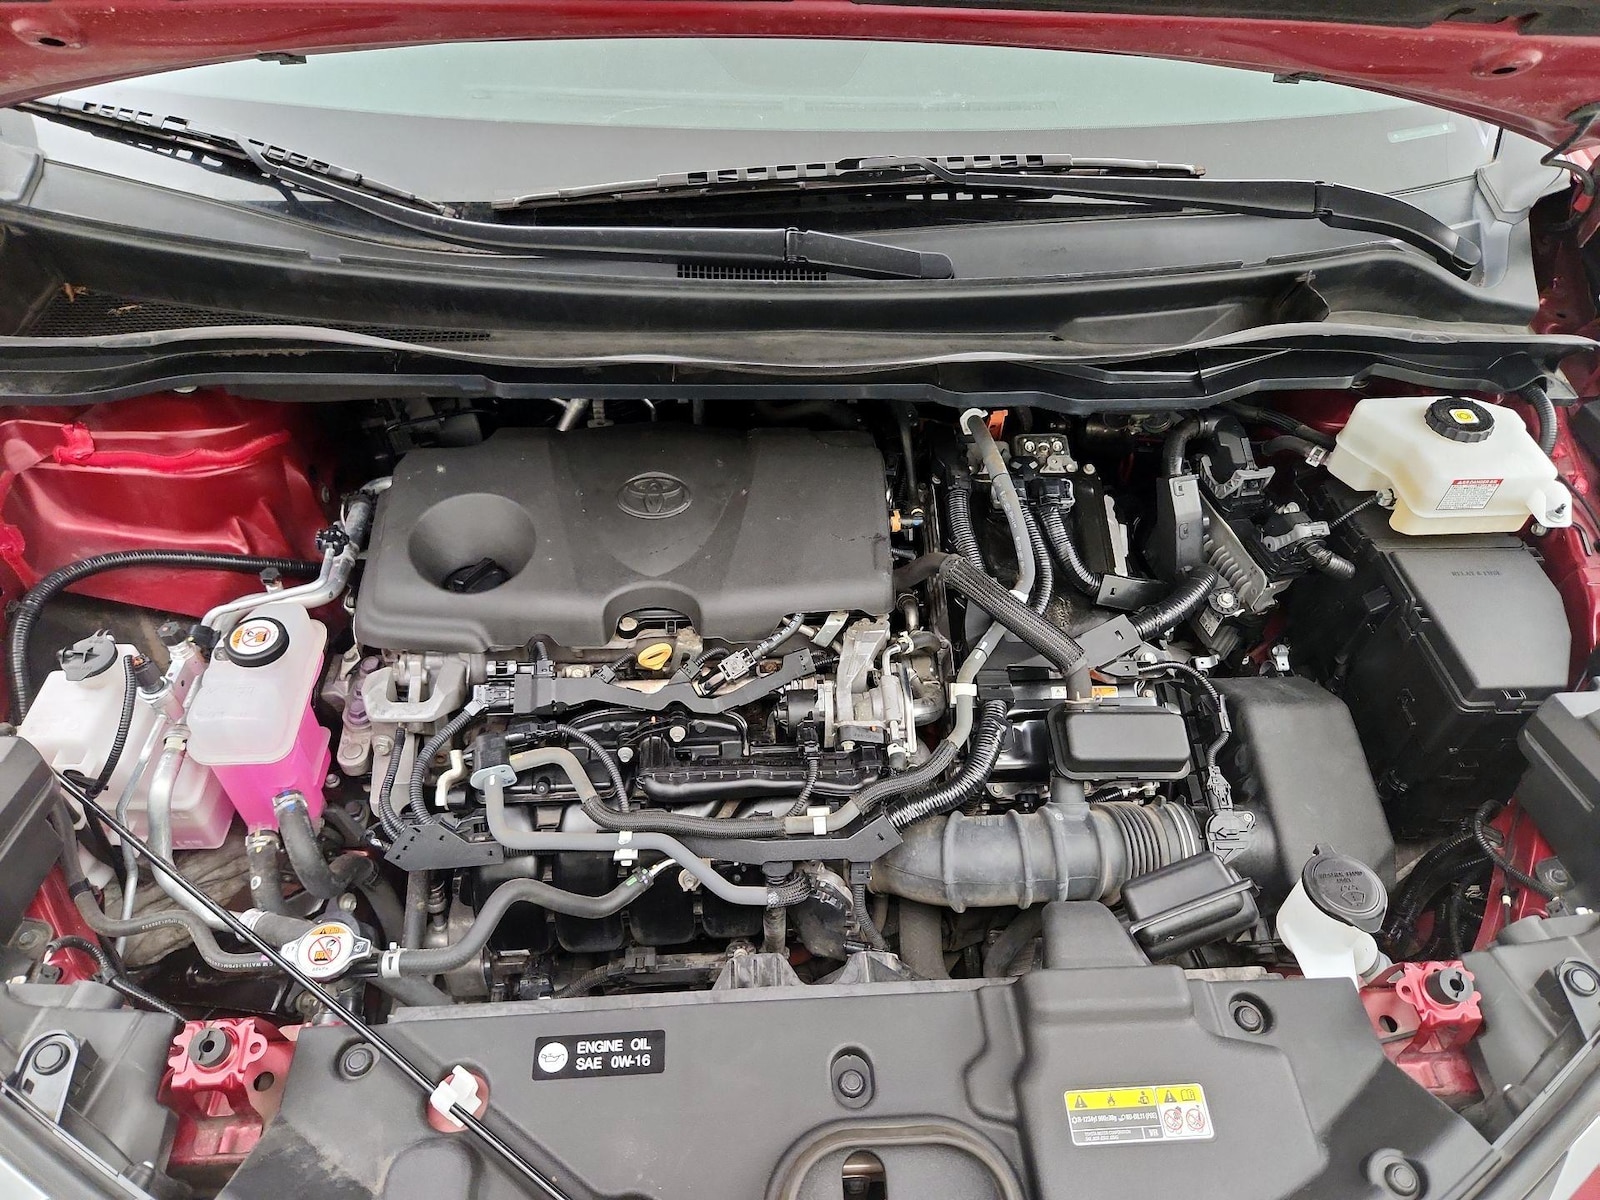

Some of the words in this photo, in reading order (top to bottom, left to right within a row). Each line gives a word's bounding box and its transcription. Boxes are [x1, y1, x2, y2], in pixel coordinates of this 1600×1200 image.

[577, 1039, 623, 1054] ENGINE
[630, 1037, 651, 1051] OIL
[575, 1057, 602, 1071] SAE
[611, 1054, 650, 1069] 0W-16
